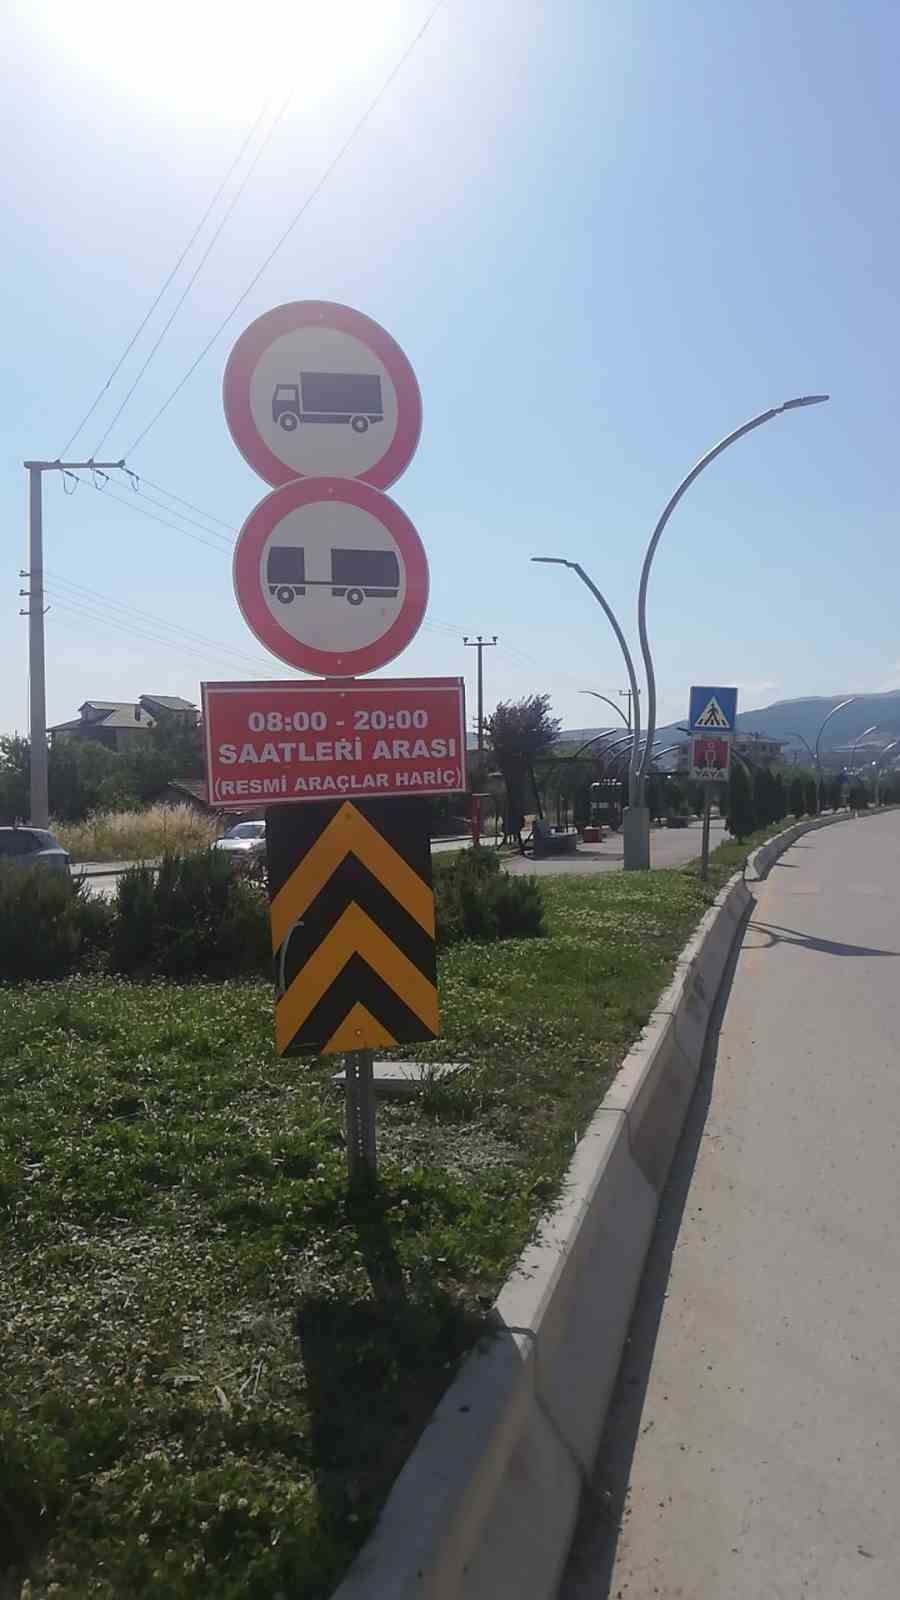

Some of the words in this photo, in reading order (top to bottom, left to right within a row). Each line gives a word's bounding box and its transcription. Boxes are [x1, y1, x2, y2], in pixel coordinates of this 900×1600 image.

[248, 711, 327, 732] 08:00
[353, 710, 428, 731] 20:00
[218, 737, 362, 764] SAATLERİ
[372, 738, 456, 760] ARASI
[214, 775, 286, 801] (RESMİ
[294, 773, 389, 793] ARAÇLAR
[396, 767, 463, 787] HARİÇ)
